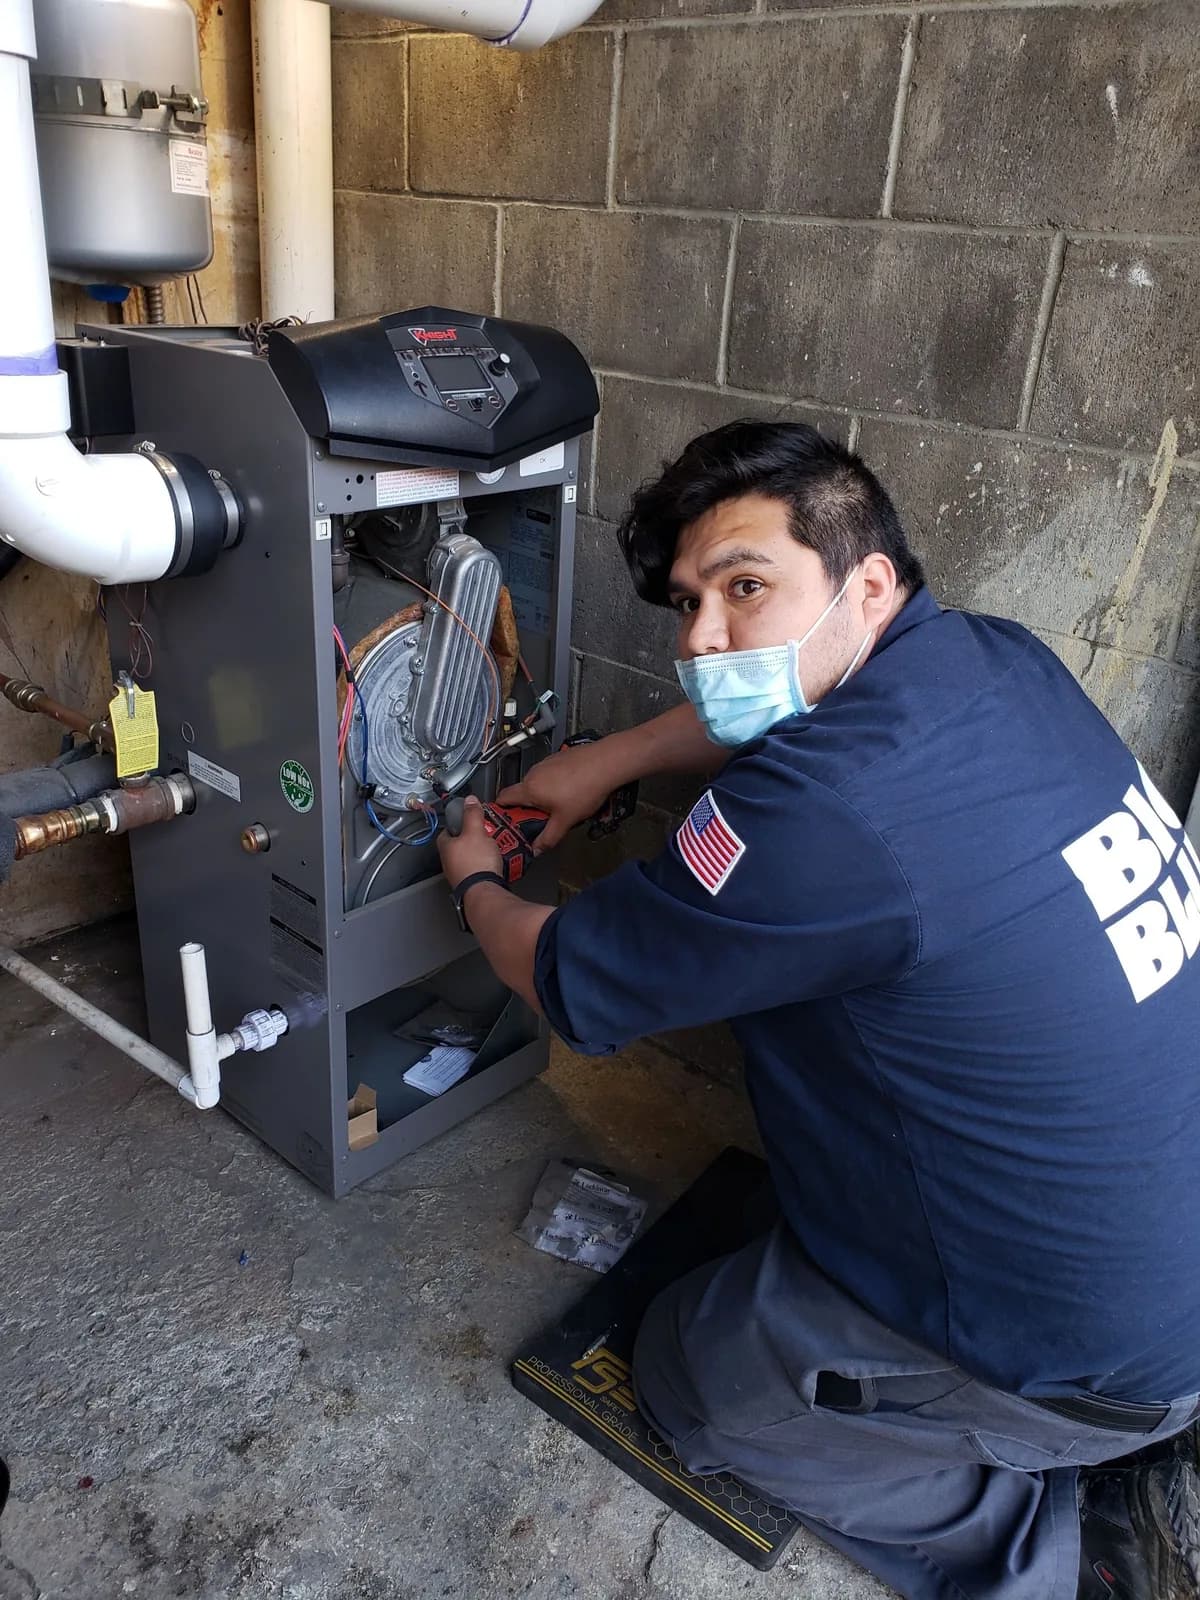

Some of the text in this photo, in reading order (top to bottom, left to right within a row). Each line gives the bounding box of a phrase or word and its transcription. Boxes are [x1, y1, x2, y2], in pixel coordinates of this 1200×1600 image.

[414, 327, 457, 340] KNIGHT
[283, 766, 297, 783] LOW
[527, 1355, 640, 1441] PROFESSIONAL GRADE
[600, 1396, 629, 1418] SAFETY
